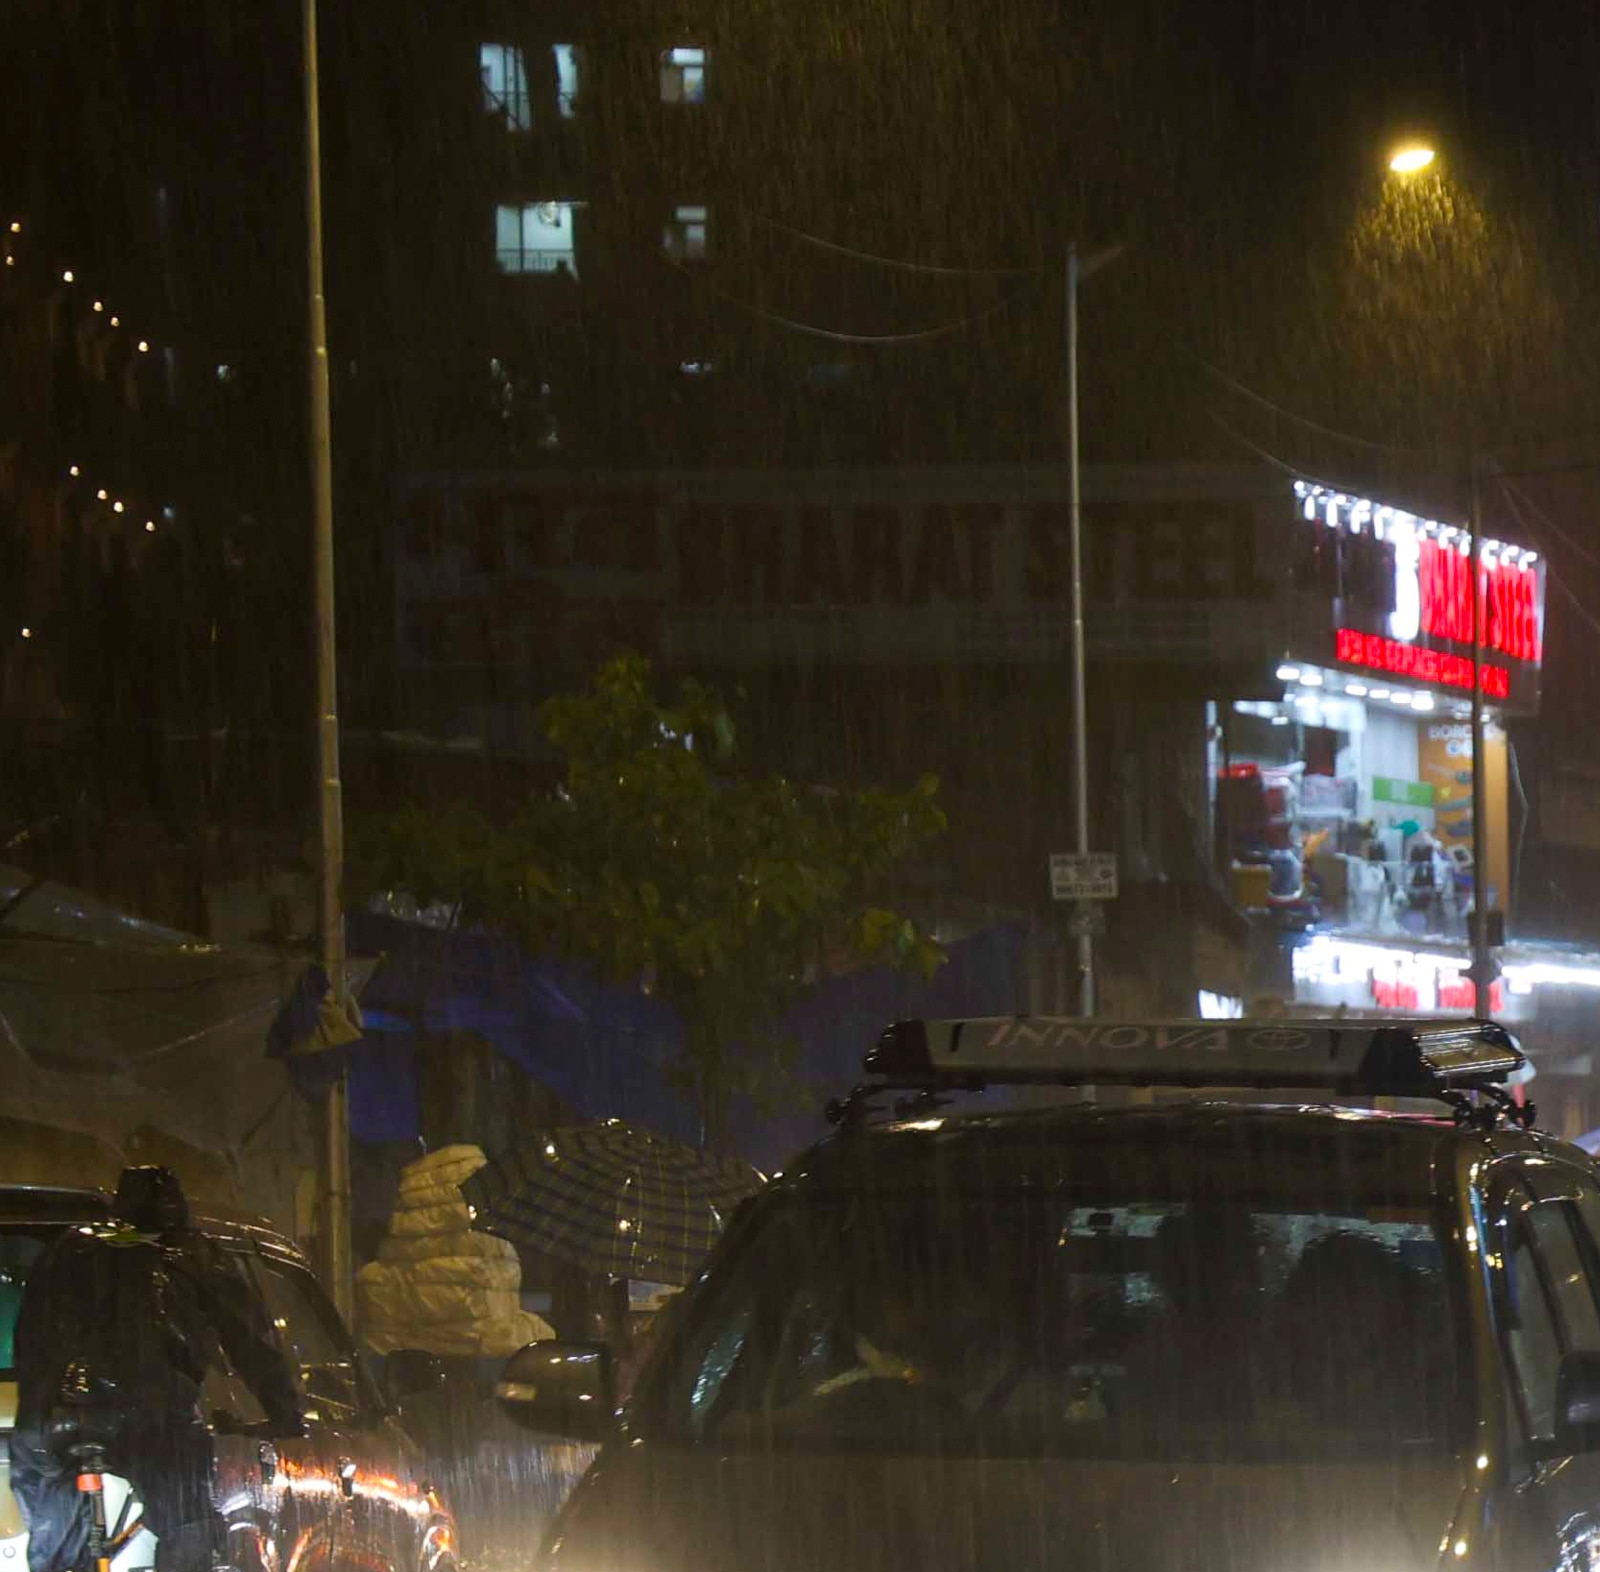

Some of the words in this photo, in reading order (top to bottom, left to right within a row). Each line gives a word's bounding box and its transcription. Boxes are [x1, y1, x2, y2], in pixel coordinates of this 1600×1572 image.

[675, 503, 1006, 607] BHARAT
[1023, 497, 1275, 601] STEEL
[986, 1024, 1229, 1050] INNOVA
